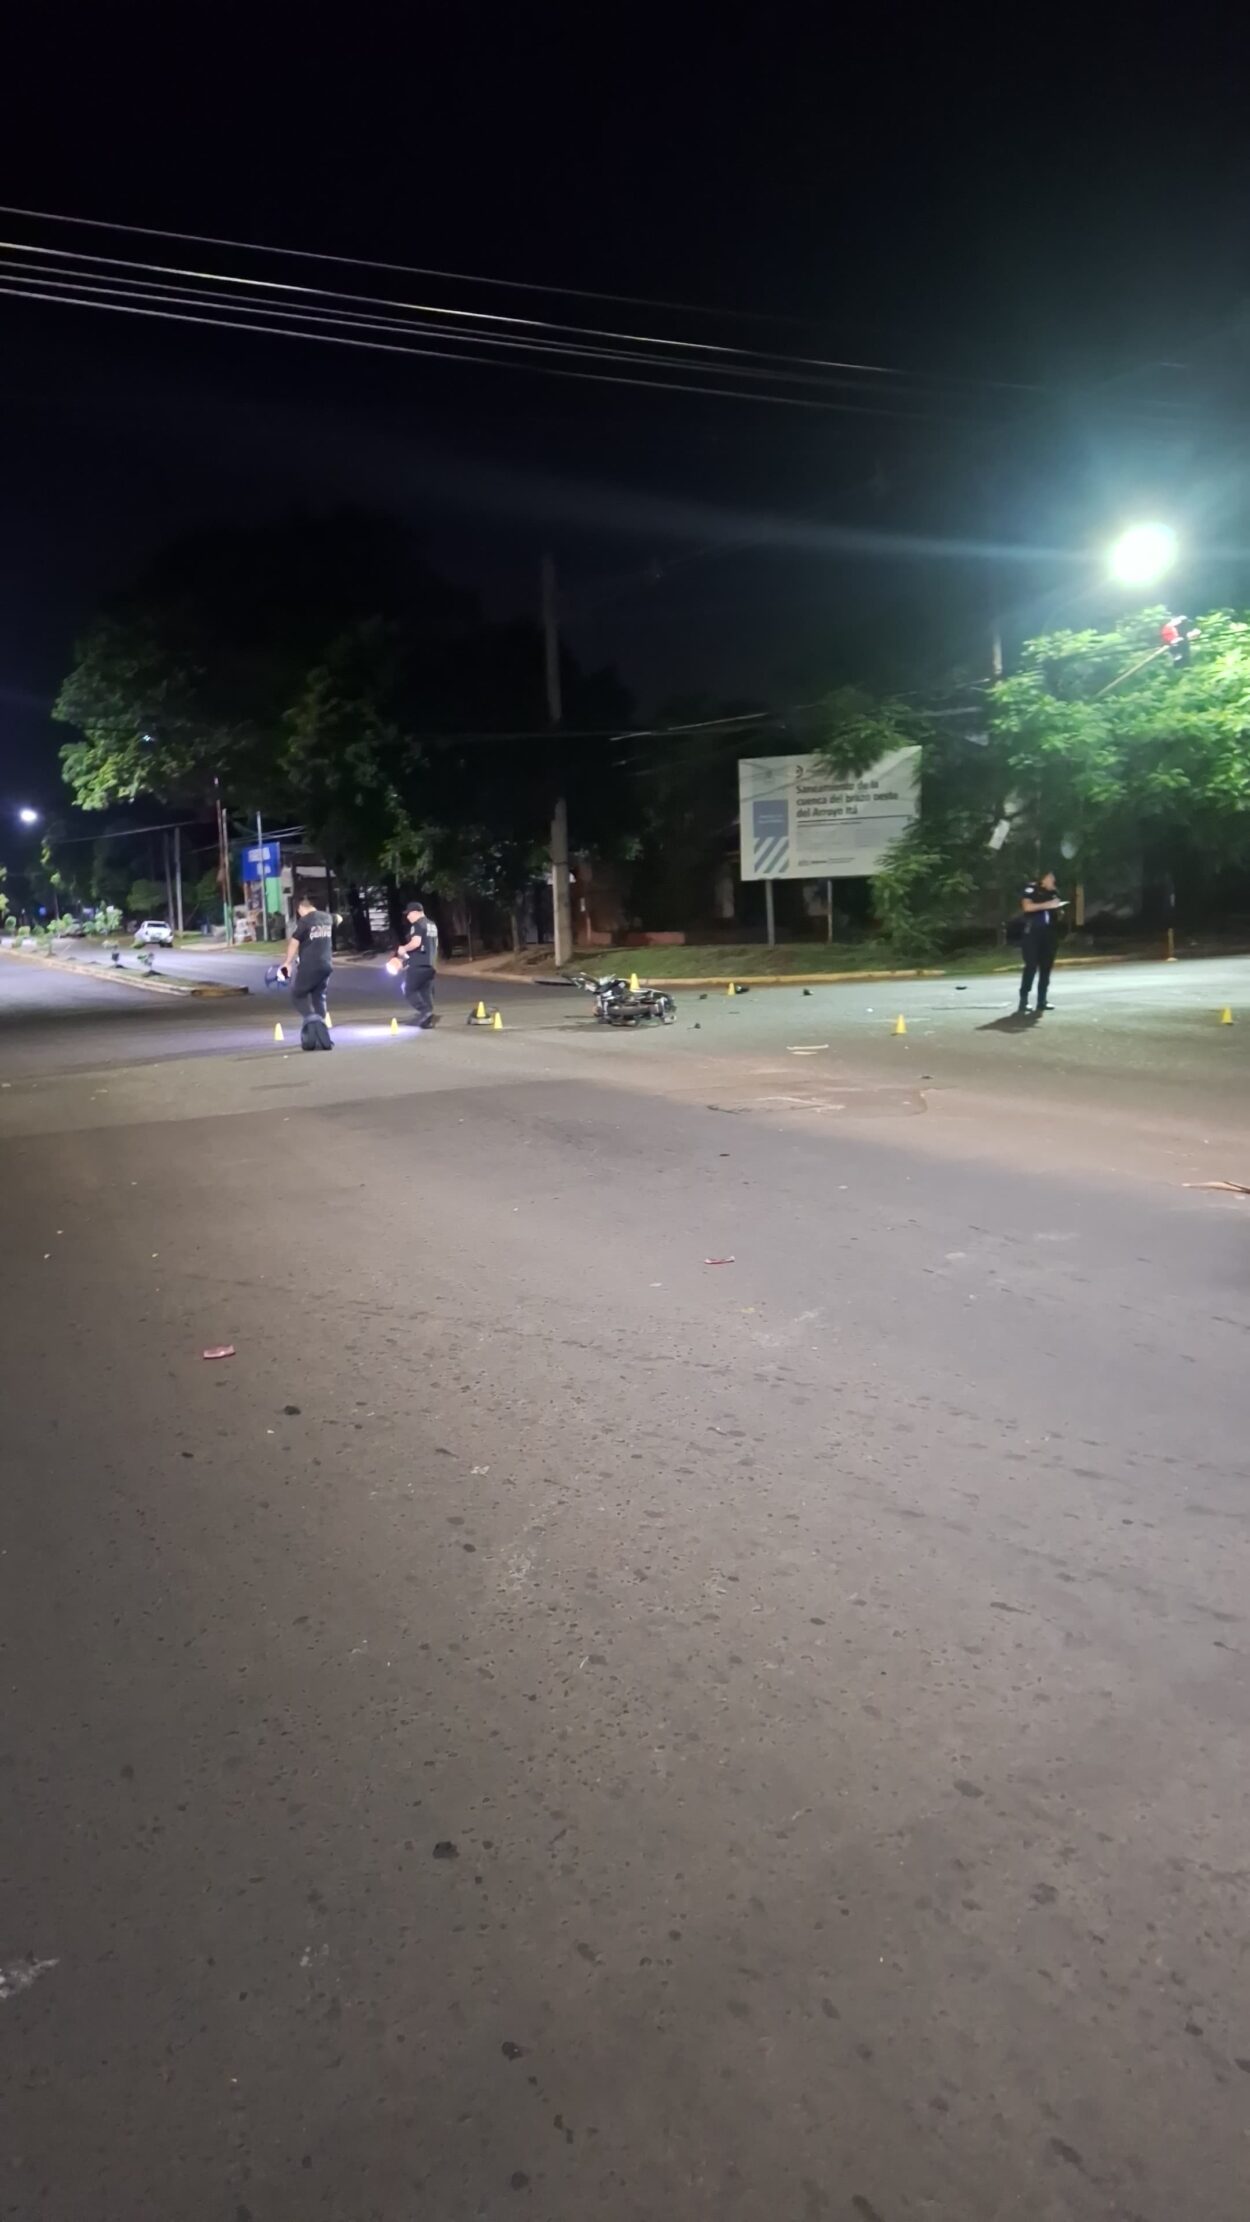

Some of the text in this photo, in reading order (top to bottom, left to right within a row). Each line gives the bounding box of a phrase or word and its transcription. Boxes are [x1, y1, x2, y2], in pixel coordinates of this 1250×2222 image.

[796, 797, 827, 806] cuenca
[829, 794, 843, 804] del
[796, 807, 810, 818] del
[812, 807, 843, 817] Arroyo
